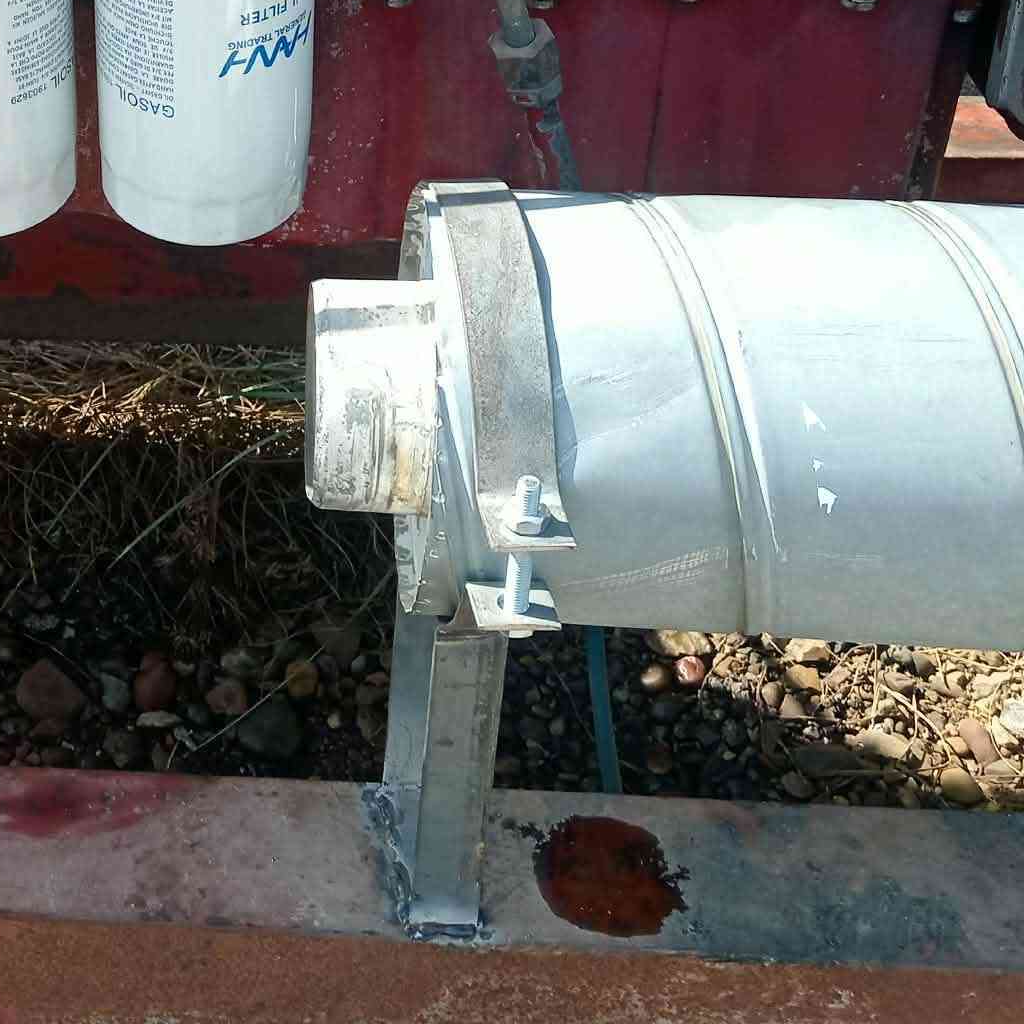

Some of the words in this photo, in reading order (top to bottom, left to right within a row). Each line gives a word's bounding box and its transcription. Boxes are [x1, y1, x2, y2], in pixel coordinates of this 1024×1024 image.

[240, 0, 288, 26] FILTER
[227, 33, 273, 51] TRADING
[115, 84, 174, 118] GASOIL
